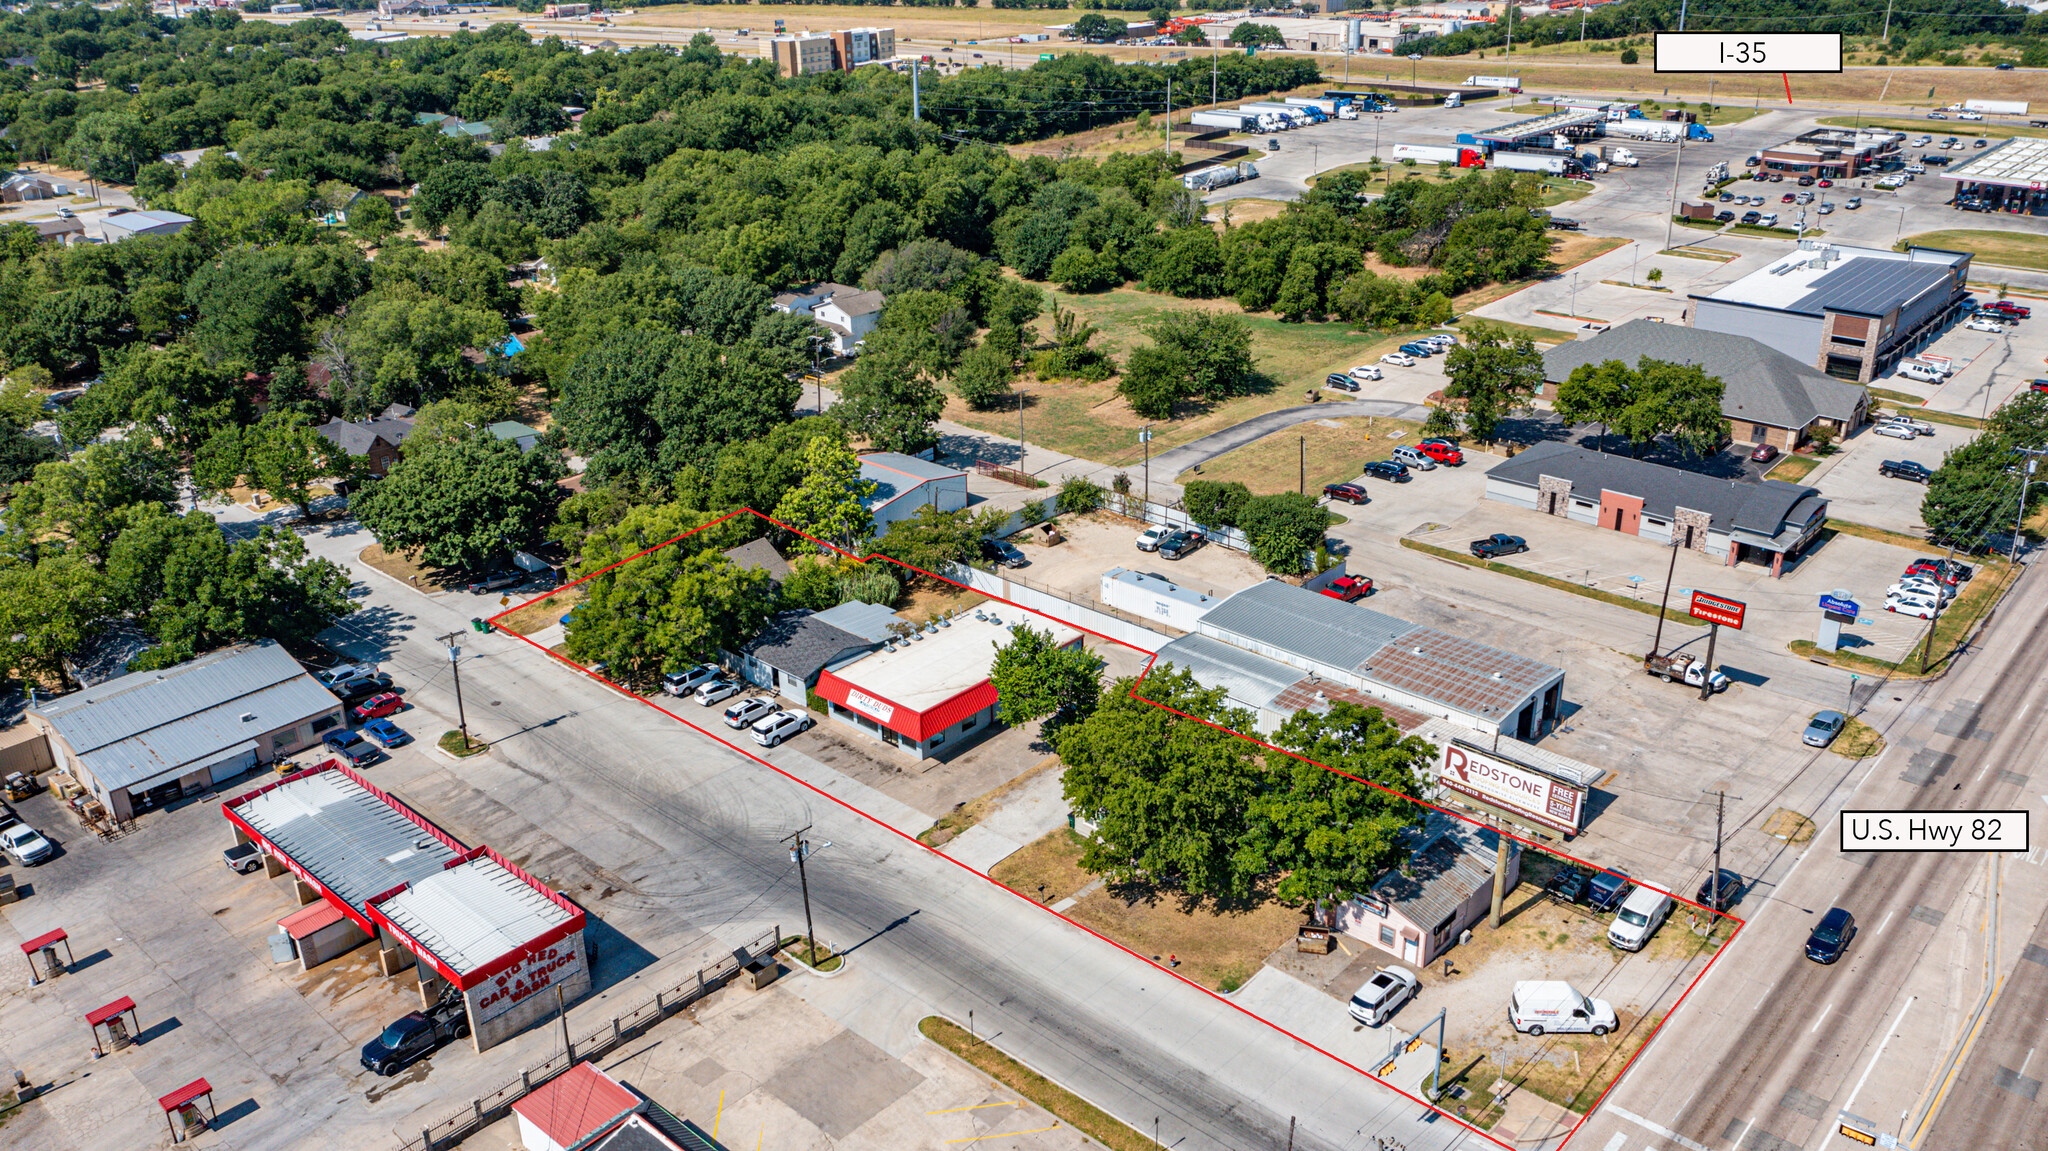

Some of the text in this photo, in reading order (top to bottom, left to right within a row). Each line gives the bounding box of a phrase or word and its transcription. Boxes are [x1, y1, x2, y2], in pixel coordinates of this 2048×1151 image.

[1696, 595, 1740, 613] BRIDGESTONE
[1827, 599, 1852, 609] Absolute
[1693, 607, 1739, 625] Firestone
[851, 691, 872, 703] DIRTY
[873, 701, 892, 713] DUDS
[1445, 746, 1543, 797] REDSTONE
[1442, 778, 1478, 796] 940-440-2112
[1553, 785, 1574, 800] FREE
[1550, 800, 1571, 812] 5-YEAR
[387, 921, 438, 969] TRUCK WASH
[495, 949, 558, 987] BIG RED
[480, 950, 577, 1009] CAR & TRUCK
[509, 975, 550, 1003] WASH
